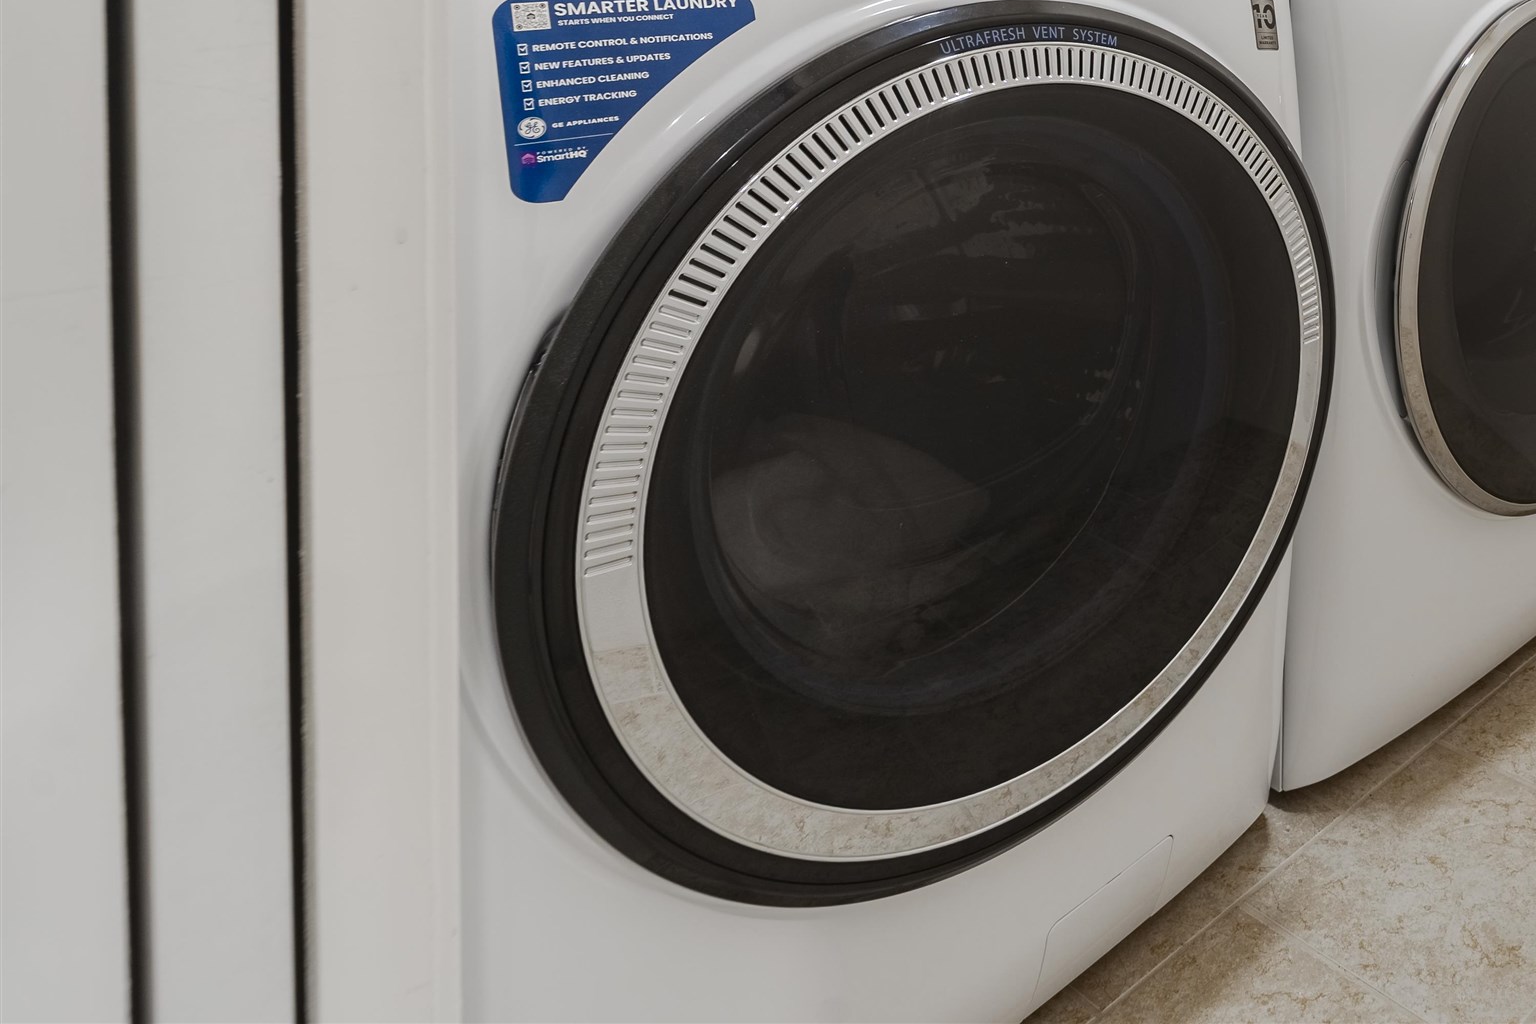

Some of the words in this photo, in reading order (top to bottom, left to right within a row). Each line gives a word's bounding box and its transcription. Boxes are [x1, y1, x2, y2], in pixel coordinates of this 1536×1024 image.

[554, 0, 649, 16] SMARTER
[1252, 4, 1276, 29] 10
[532, 42, 576, 52] REMOTE
[578, 38, 628, 48] CONTROL
[640, 32, 713, 44] NOTIFICATIONS
[940, 27, 1026, 55] ULTRAFRESH
[1032, 26, 1066, 39] VENT
[1072, 28, 1117, 47] SYSTEM
[534, 61, 560, 71] NEW
[563, 57, 614, 68] FEATURES
[626, 52, 671, 63] UPDATES
[536, 76, 596, 88] ENHANCED
[598, 71, 650, 83] CLEANING
[538, 95, 581, 107] ENERGY
[582, 90, 637, 101] TRACKING
[566, 116, 620, 127] APPLIANCES
